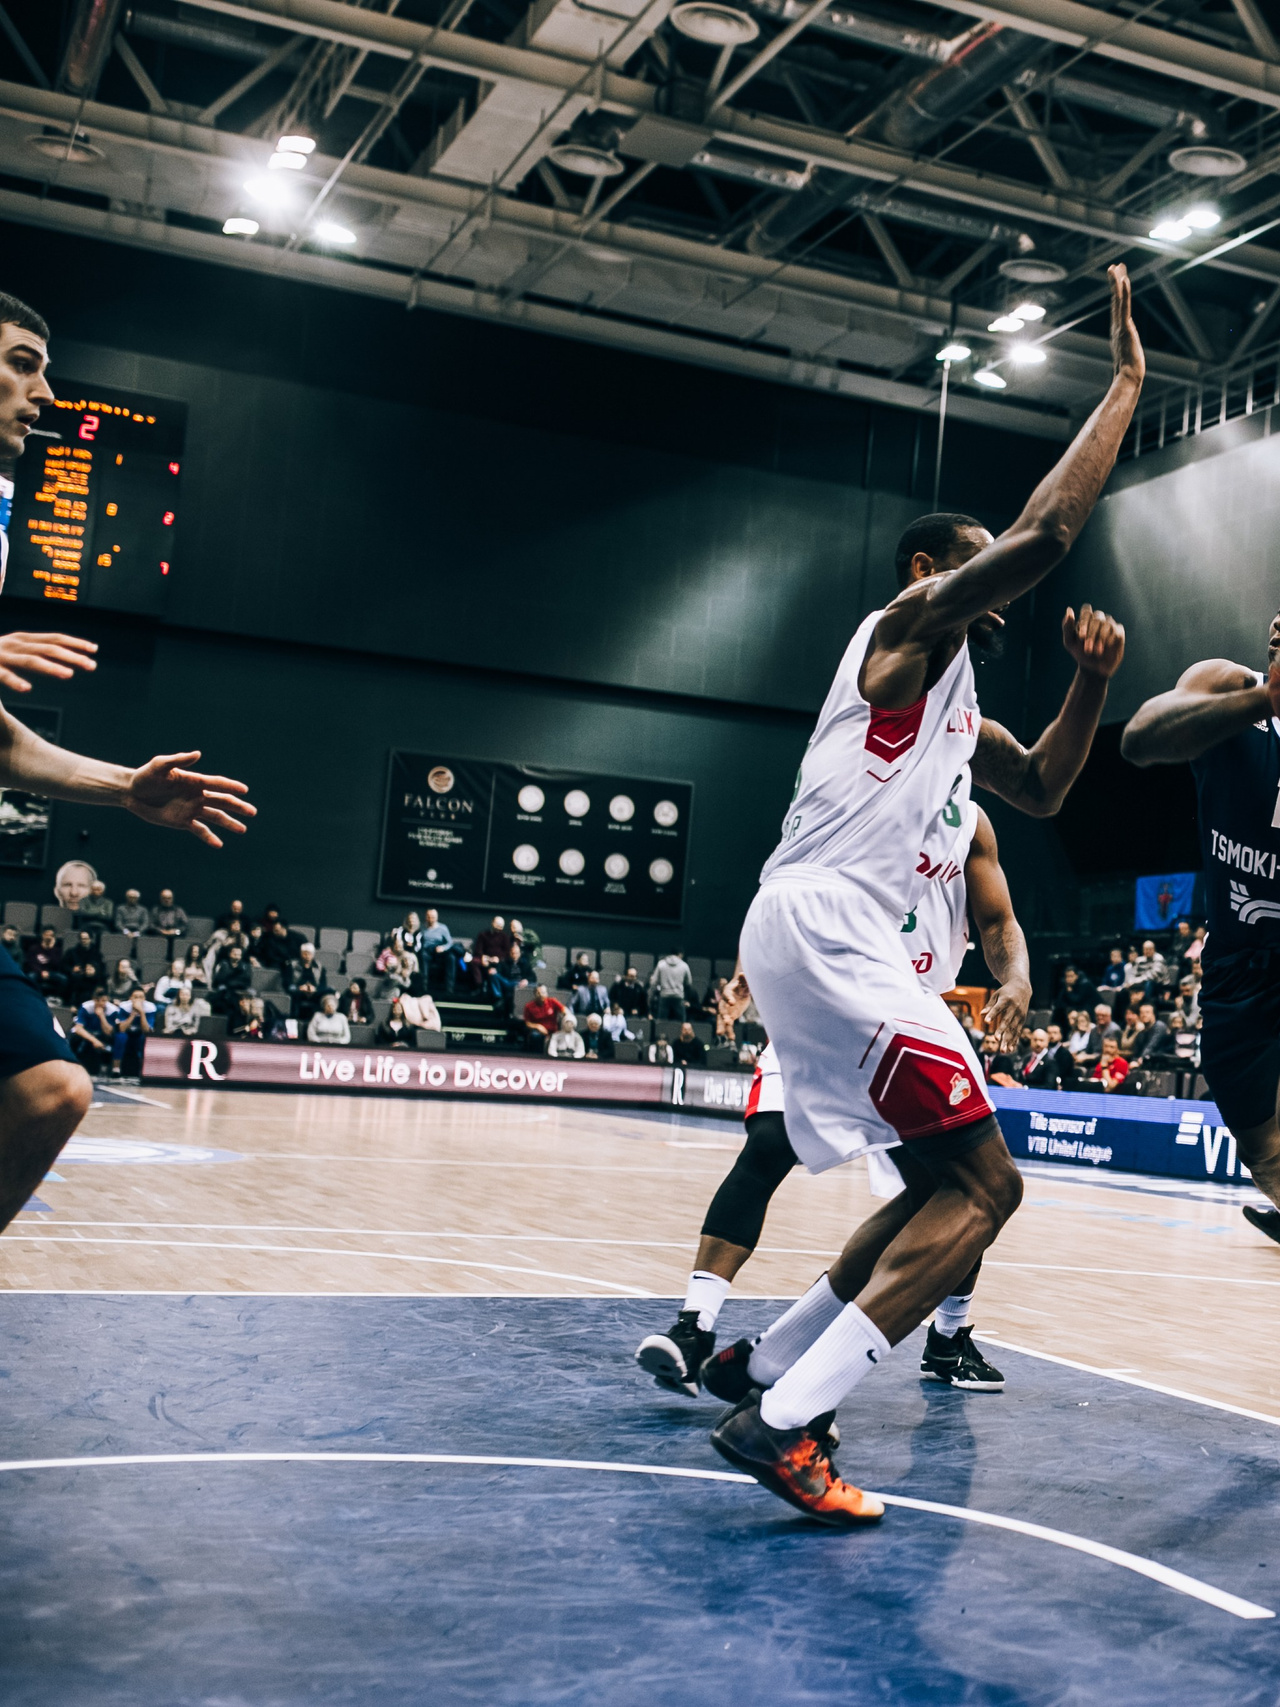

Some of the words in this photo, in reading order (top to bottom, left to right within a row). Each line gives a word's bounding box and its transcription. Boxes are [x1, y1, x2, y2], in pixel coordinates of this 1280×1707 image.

[78, 414, 100, 441] 2
[404, 793, 474, 814] FALCON
[186, 1040, 227, 1081] R
[299, 1051, 355, 1082] Live
[363, 1055, 411, 1085] Life
[418, 1057, 447, 1087] to
[453, 1059, 568, 1093] Discover
[672, 1067, 685, 1106] R
[704, 1076, 723, 1105] Live
[724, 1078, 742, 1107] Life
[743, 1080, 752, 1107] t
[1048, 1117, 1085, 1136] sponsor
[1085, 1117, 1098, 1136] of
[1028, 1135, 1048, 1155] VTB
[1048, 1137, 1078, 1158] United
[1078, 1141, 1113, 1165] League
[1203, 1125, 1253, 1179] VT
